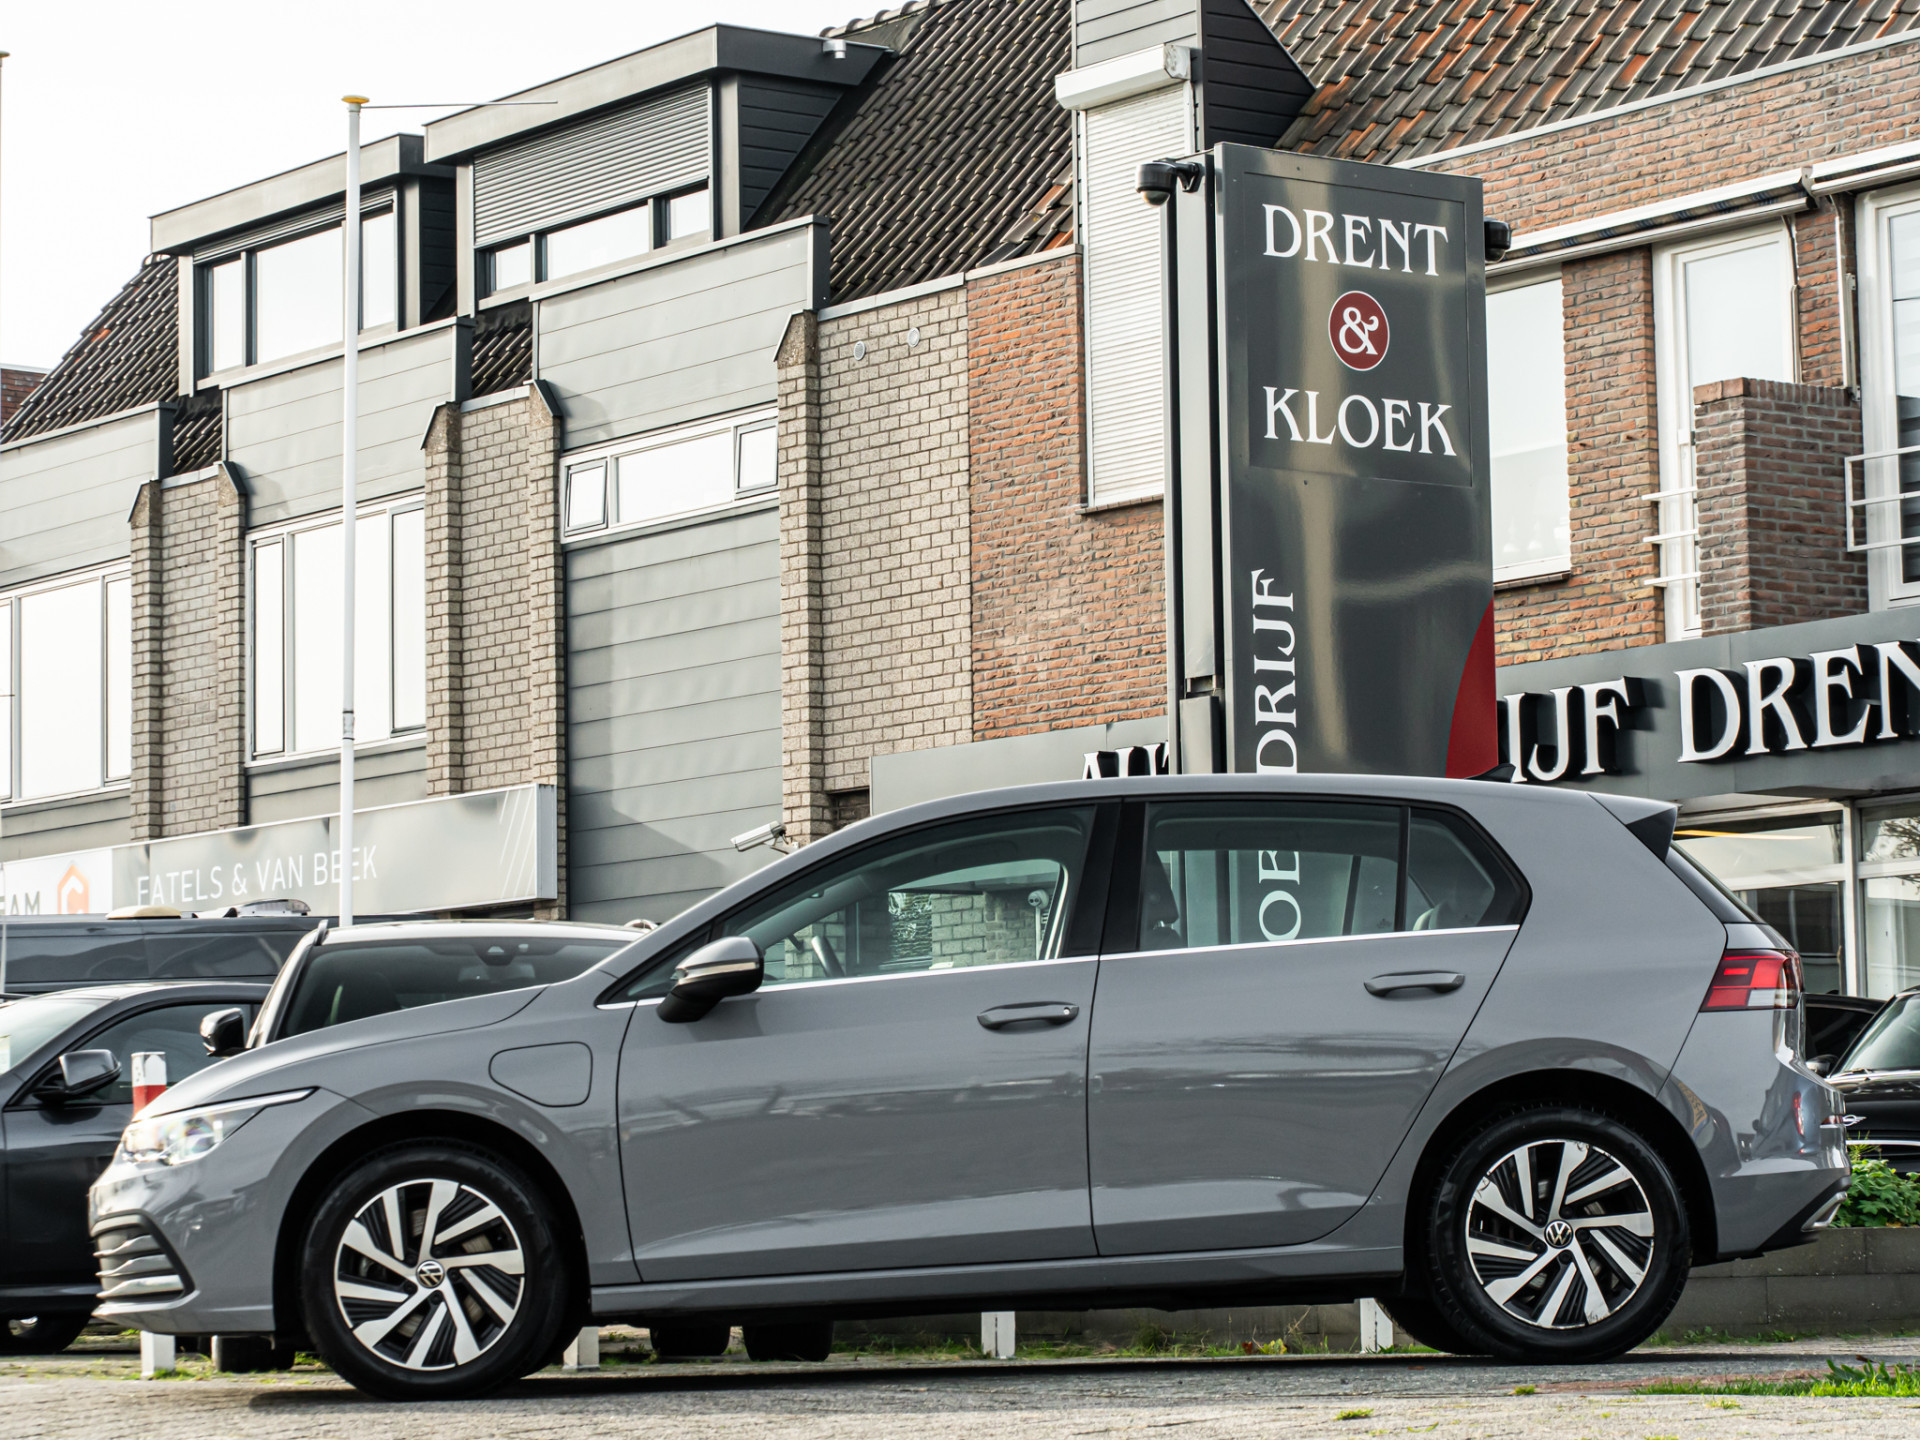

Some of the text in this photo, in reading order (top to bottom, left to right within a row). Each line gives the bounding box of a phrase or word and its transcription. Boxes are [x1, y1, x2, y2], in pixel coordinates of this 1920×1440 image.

[1262, 203, 1449, 277] DRENT
[1339, 306, 1379, 355] &
[1262, 386, 1457, 456] KLOEK
[231, 862, 248, 896] &
[256, 854, 303, 892] VAN
